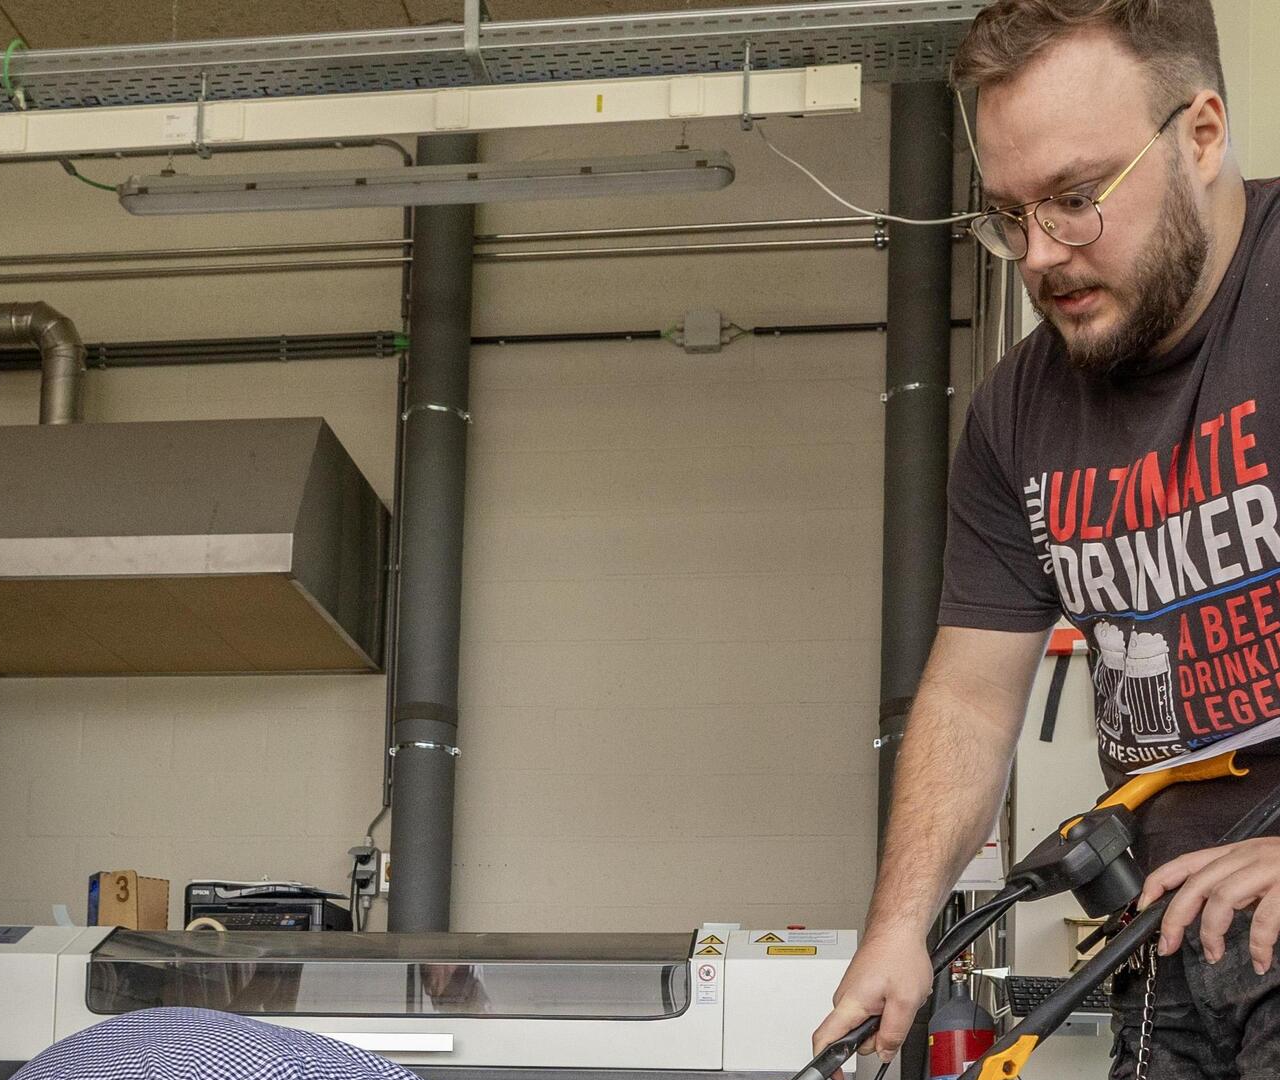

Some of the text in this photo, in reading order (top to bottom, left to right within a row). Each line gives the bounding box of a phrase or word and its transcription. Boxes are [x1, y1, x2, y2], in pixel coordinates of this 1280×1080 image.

[1049, 400, 1268, 543] ULTIMATE
[1178, 613, 1197, 660] A
[1109, 742, 1187, 764] RESULTS
[115, 875, 129, 903] 3
